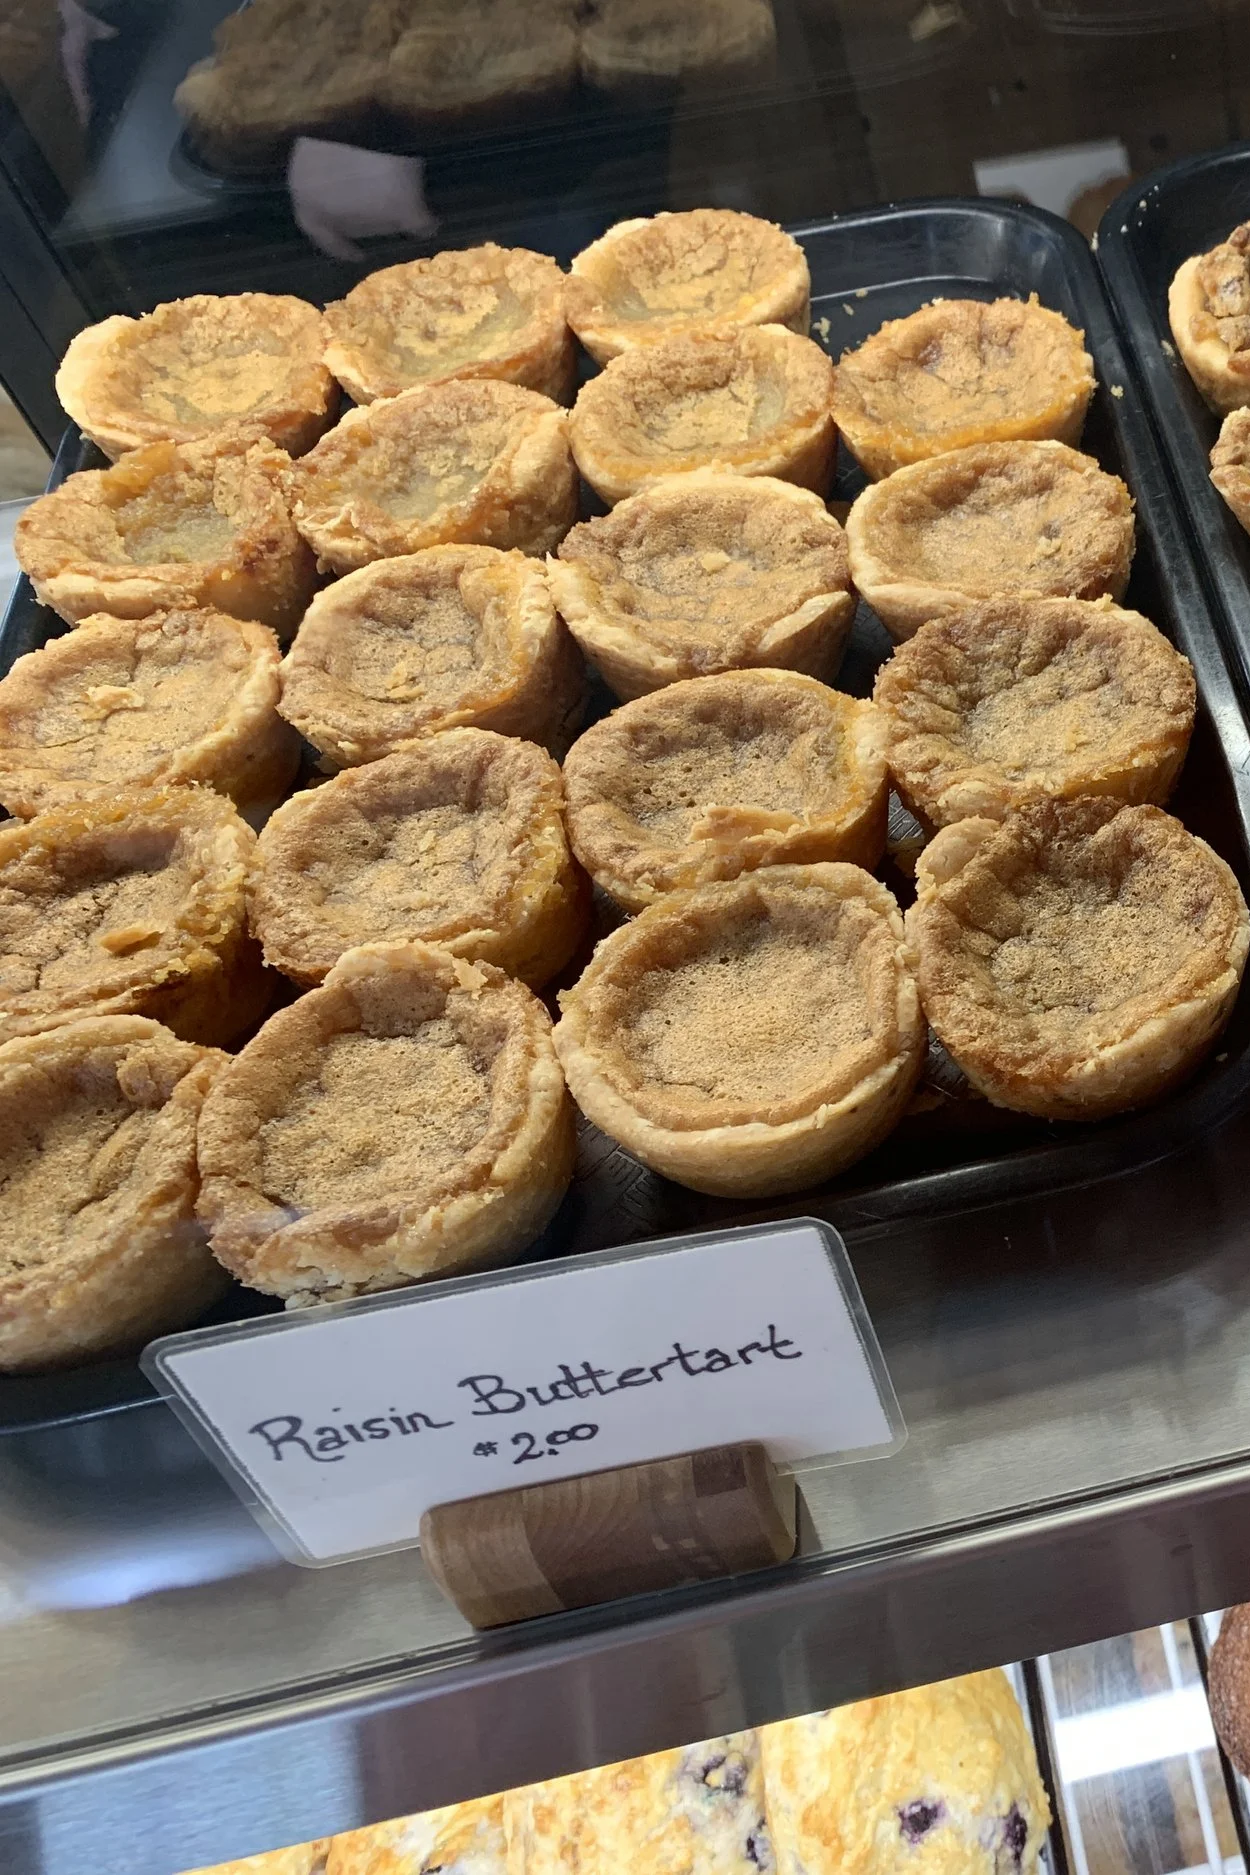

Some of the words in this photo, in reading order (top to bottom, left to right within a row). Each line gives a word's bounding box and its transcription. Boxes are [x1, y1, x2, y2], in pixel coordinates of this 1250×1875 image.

[249, 1408, 454, 1463] Raisin
[457, 1324, 803, 1416] Buttertart
[472, 1423, 599, 1465] $2.00
